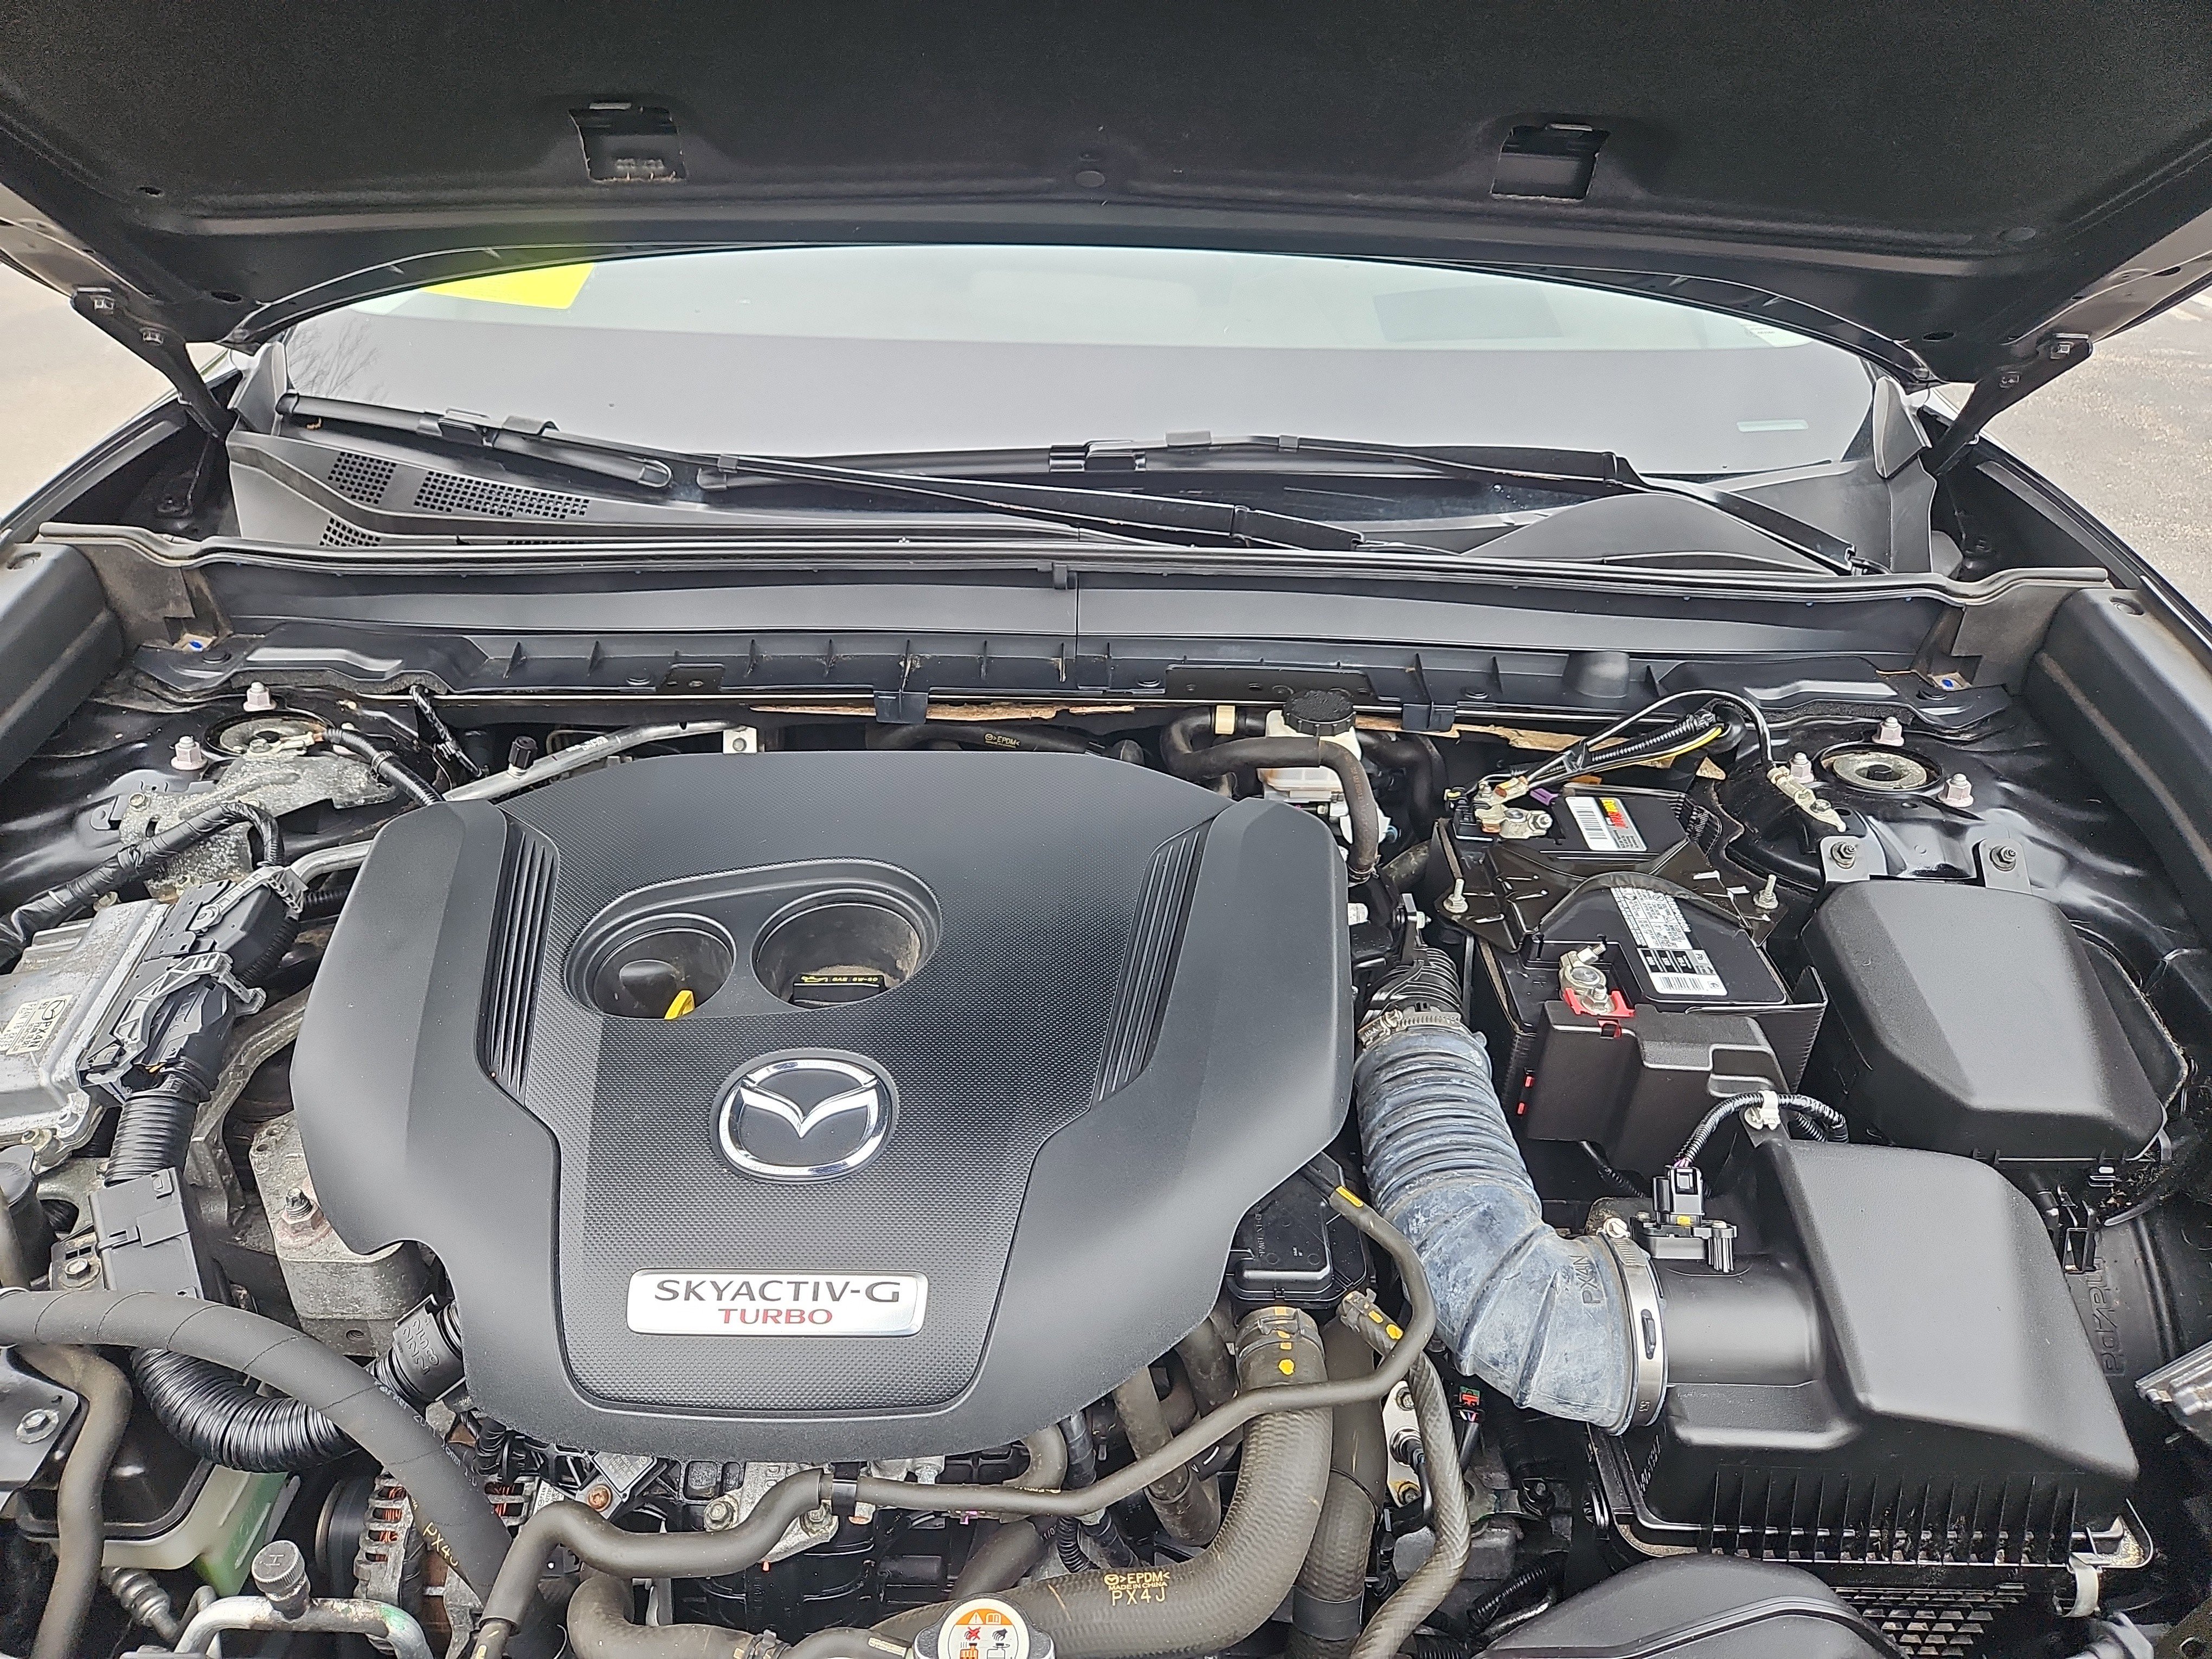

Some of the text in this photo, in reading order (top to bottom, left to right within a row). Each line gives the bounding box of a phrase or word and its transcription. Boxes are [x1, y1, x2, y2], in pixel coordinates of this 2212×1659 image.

[654, 1279, 901, 1302] SKYACTIV-G
[718, 1308, 833, 1325] TURBO
[1120, 1571, 1171, 1584] >EPDM<
[1111, 1587, 1166, 1606] PX4J
